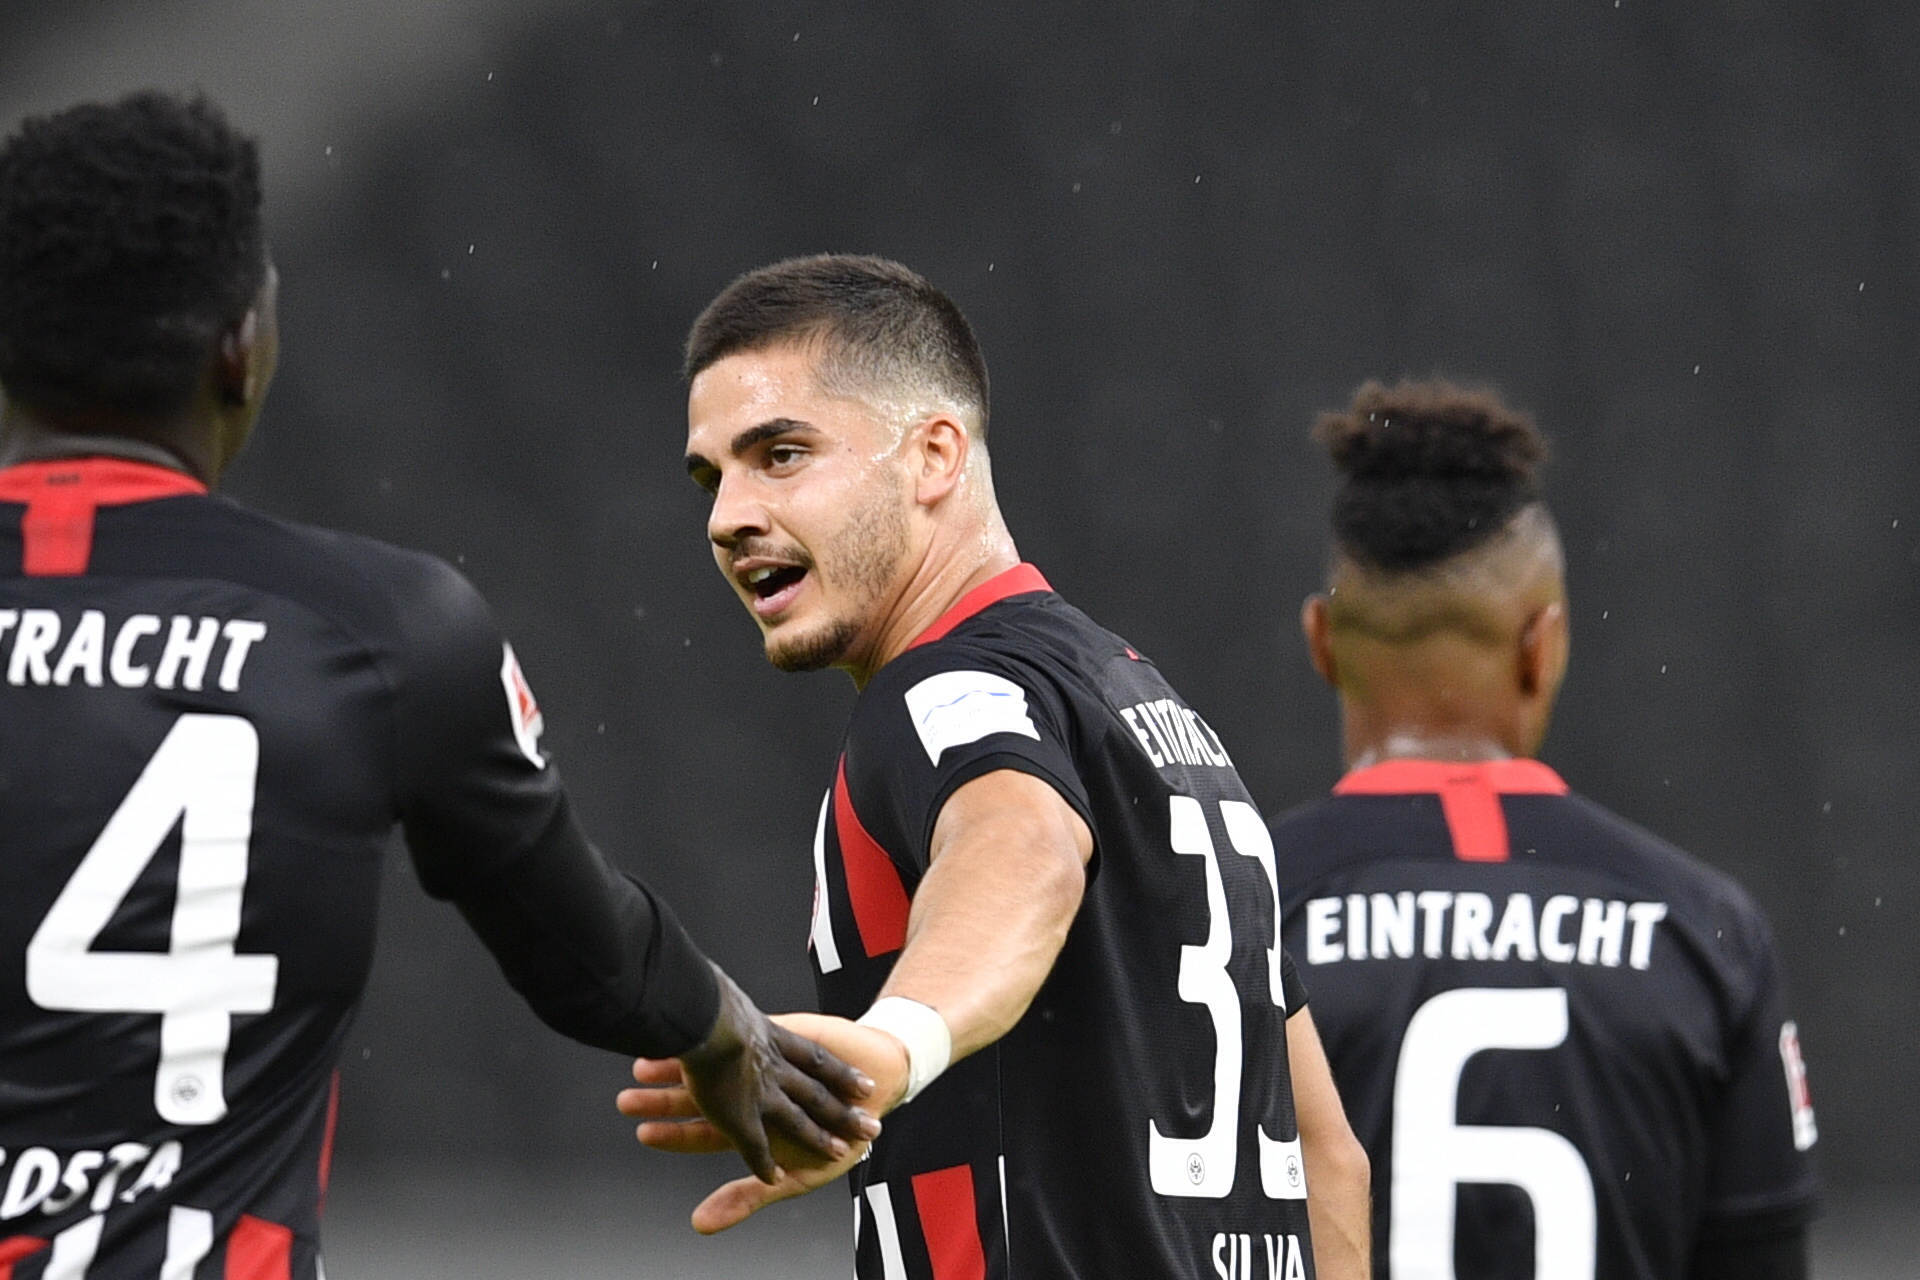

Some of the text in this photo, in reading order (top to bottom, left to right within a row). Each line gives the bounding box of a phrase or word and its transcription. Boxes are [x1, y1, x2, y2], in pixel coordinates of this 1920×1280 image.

[26, 713, 279, 1125] 4
[1149, 794, 1308, 1200] 33
[1306, 890, 1668, 971] EINTRACHT
[0, 1140, 183, 1220] OSTA
[1389, 987, 1597, 1280] 6
